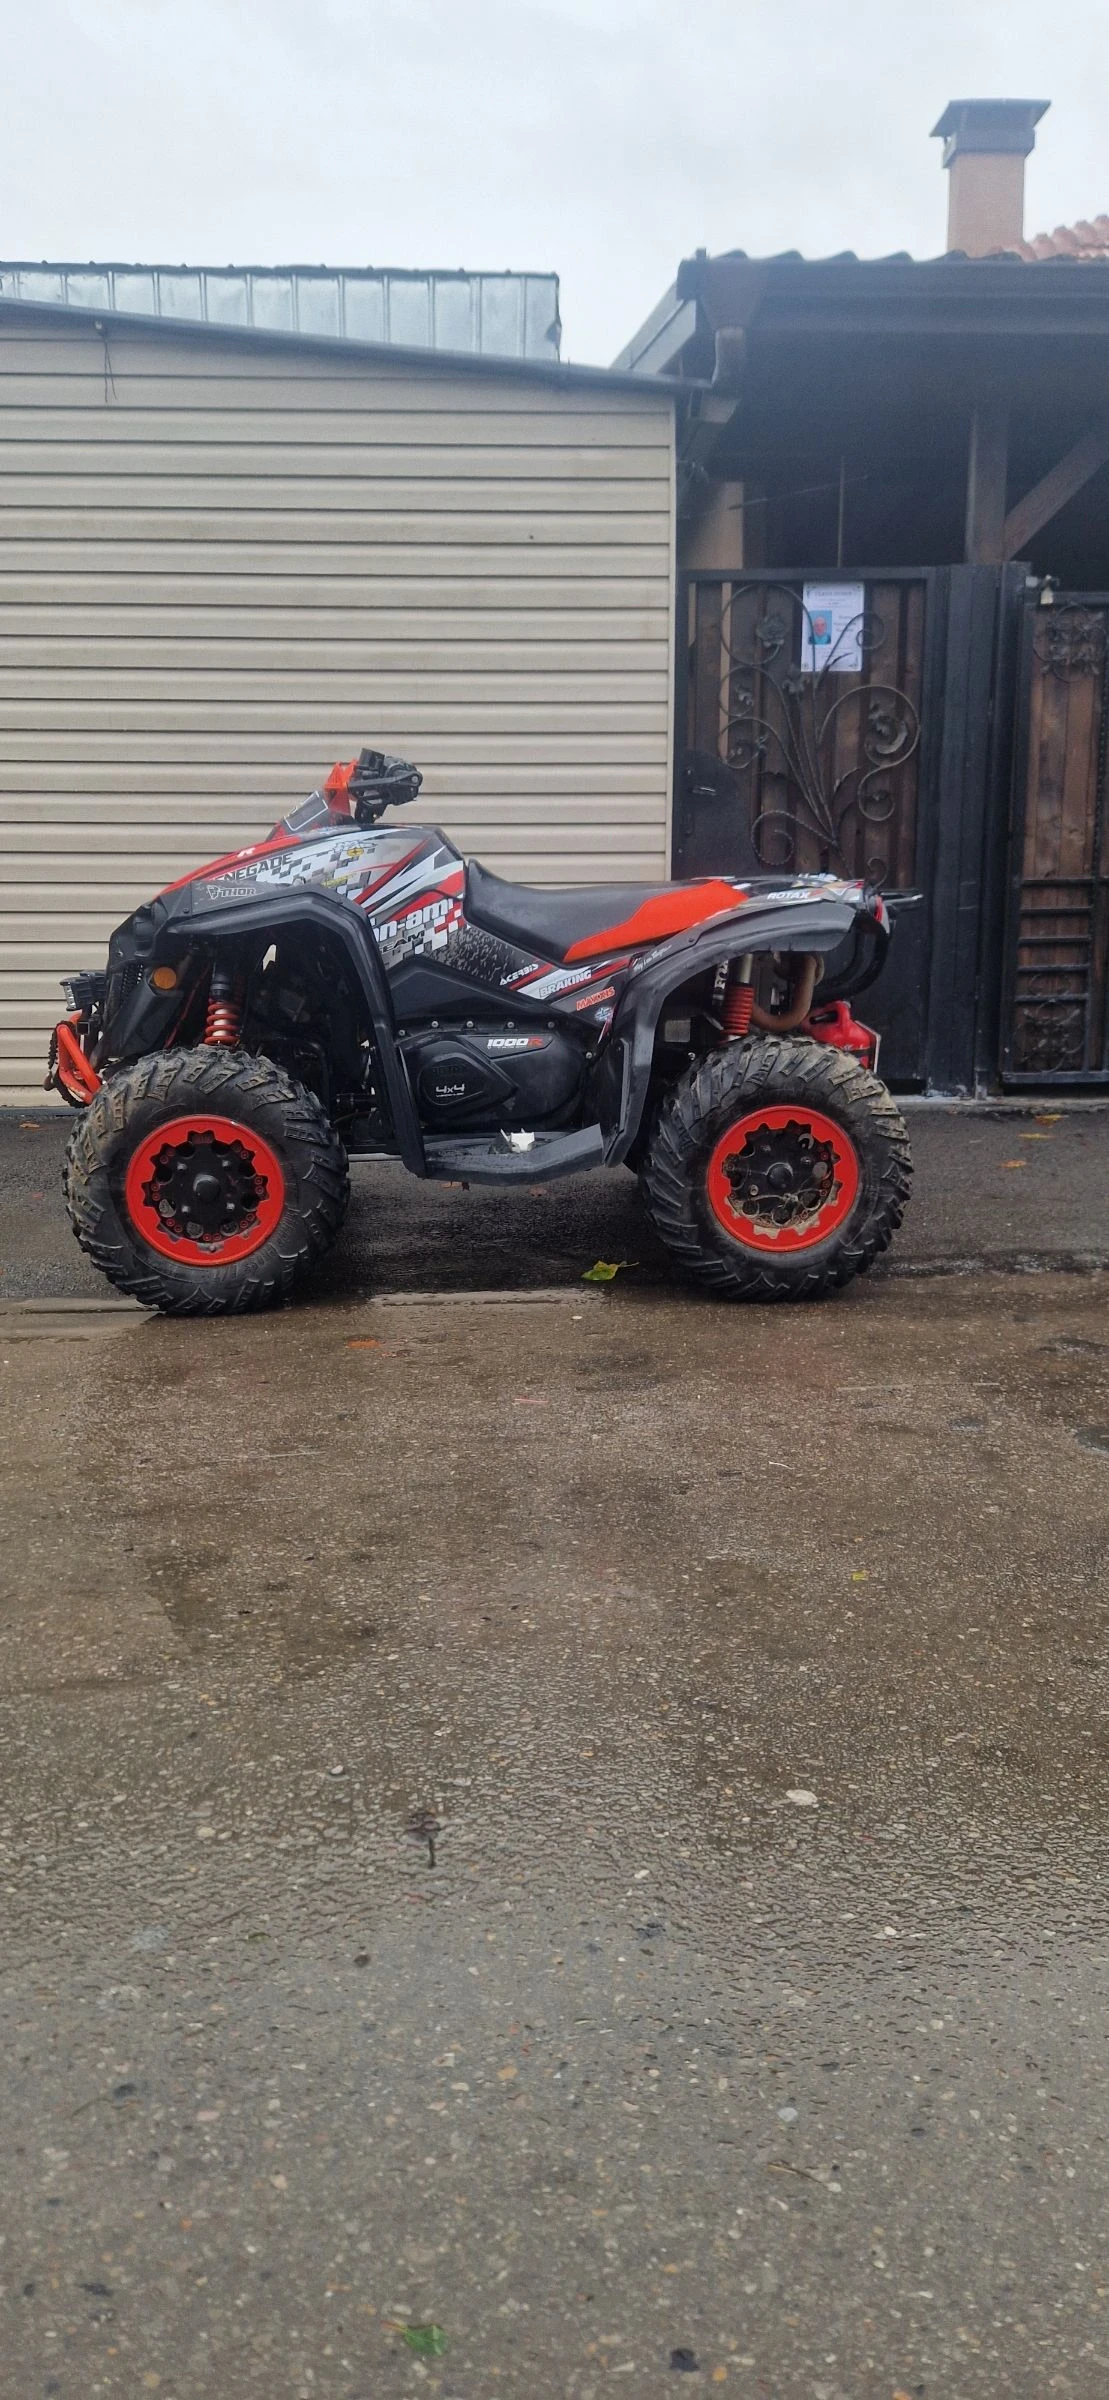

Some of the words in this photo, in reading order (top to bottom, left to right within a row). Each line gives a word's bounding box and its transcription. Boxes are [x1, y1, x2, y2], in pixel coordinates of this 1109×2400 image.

[216, 852, 293, 881] NEGADE
[220, 886, 258, 898] THOR
[767, 890, 811, 900] ROTAX
[499, 963, 539, 985] ACERBIS
[539, 970, 592, 998] BRAKING
[576, 986, 616, 1011] MAXXIS
[486, 1036, 543, 1049] 1000R
[435, 1083, 465, 1094] 4x4
